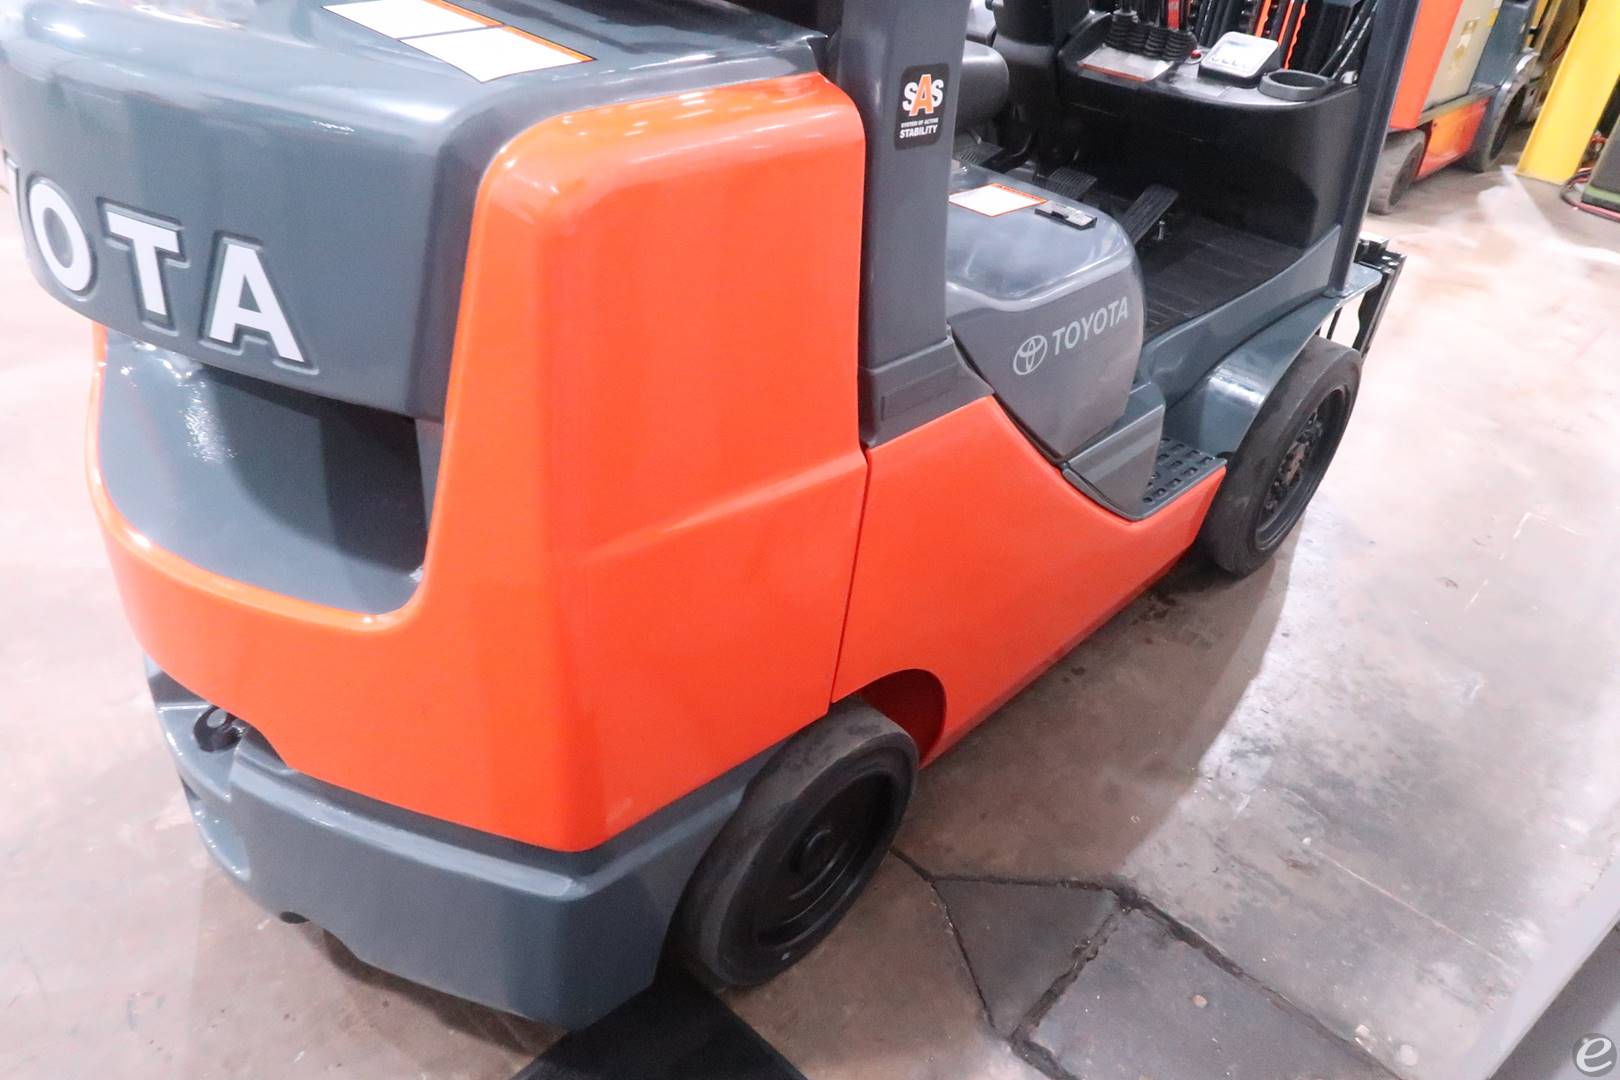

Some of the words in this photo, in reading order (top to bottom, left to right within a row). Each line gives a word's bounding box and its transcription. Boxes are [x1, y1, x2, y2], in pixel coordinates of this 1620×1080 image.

[902, 74, 944, 117] SAS
[899, 124, 938, 139] STABILITY
[3, 157, 306, 363] OTA
[1052, 296, 1129, 356] TOYOTA
